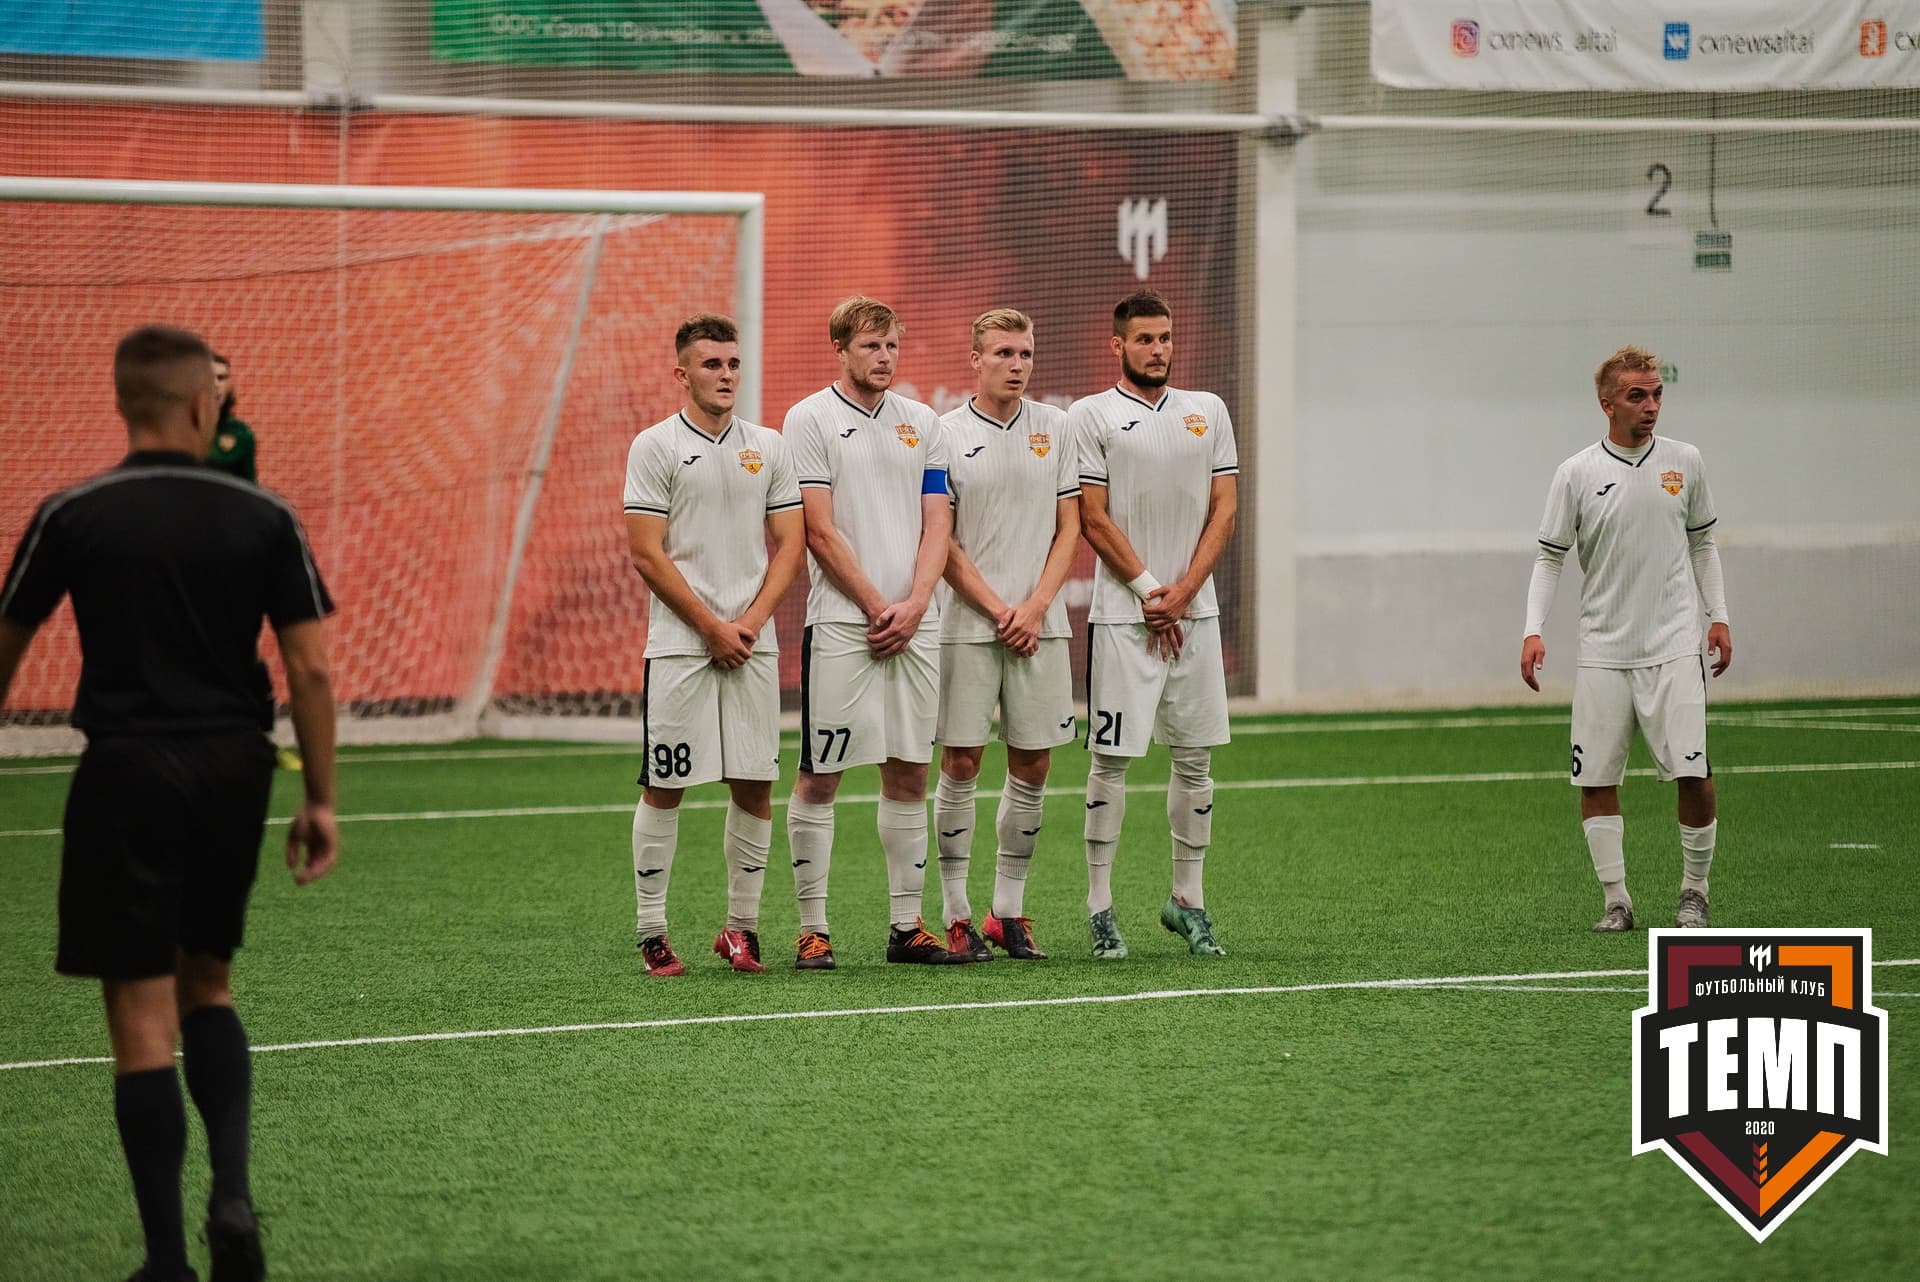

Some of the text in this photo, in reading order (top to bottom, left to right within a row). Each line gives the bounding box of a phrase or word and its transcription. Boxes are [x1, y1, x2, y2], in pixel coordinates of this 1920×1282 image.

[1646, 163, 1672, 217] 2
[817, 727, 851, 764] 77
[1095, 709, 1123, 747] 21
[653, 742, 692, 779] 98
